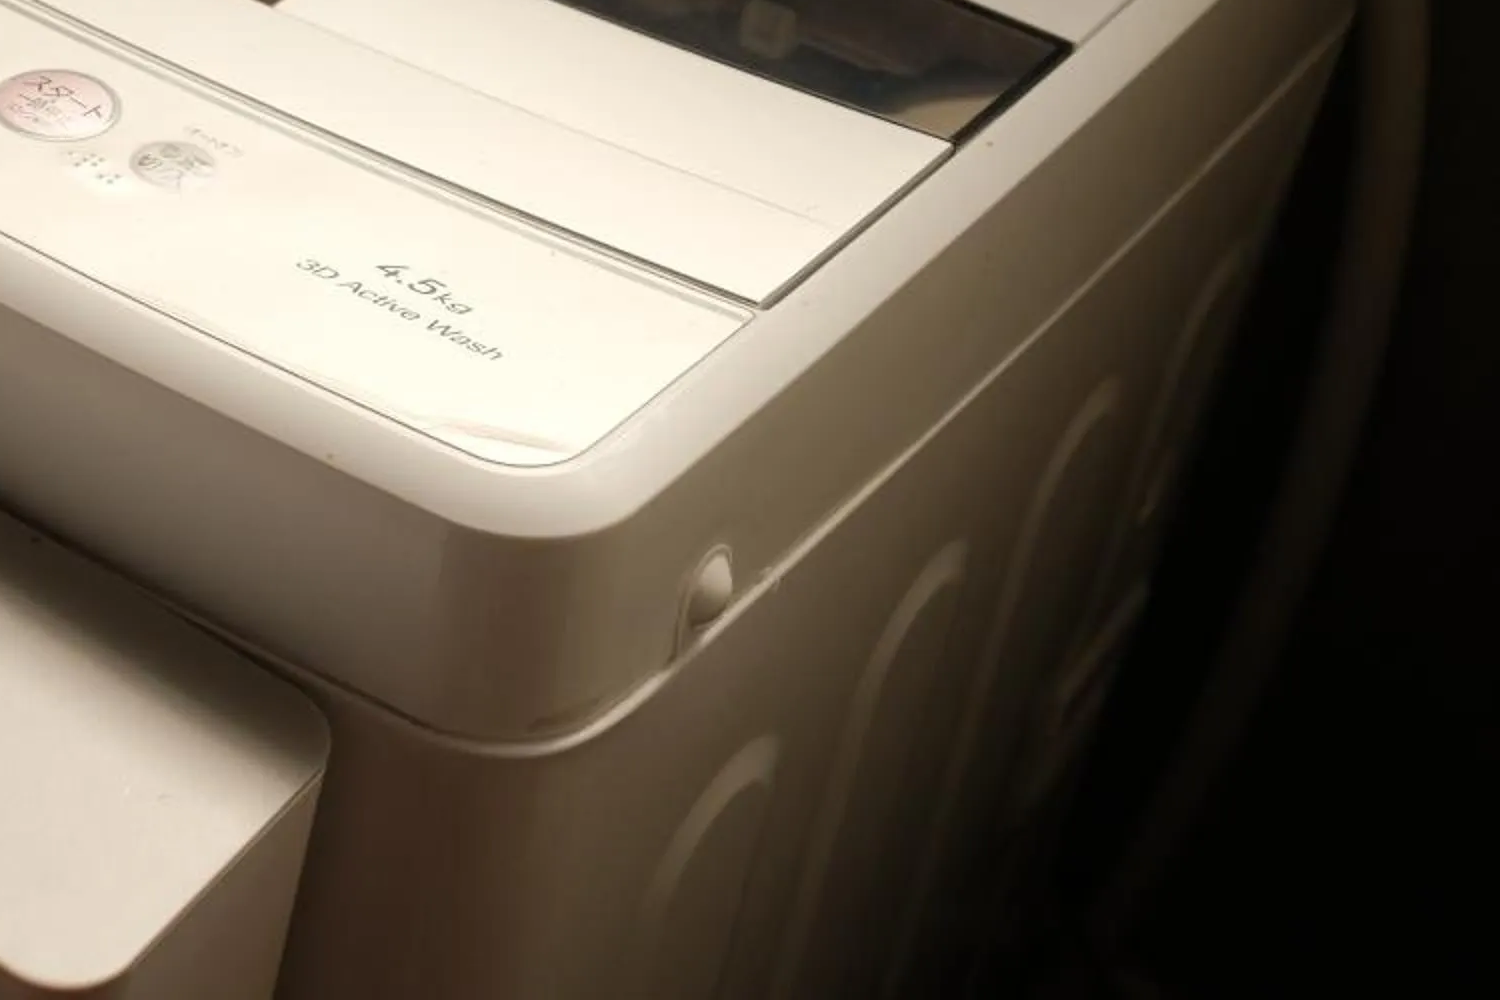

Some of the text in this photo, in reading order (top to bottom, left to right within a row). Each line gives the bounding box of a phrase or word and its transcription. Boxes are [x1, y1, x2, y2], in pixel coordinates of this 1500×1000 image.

[21, 74, 102, 120] スタート
[295, 258, 504, 361] 3D Active Wash
[375, 264, 474, 316] 4.5kg
